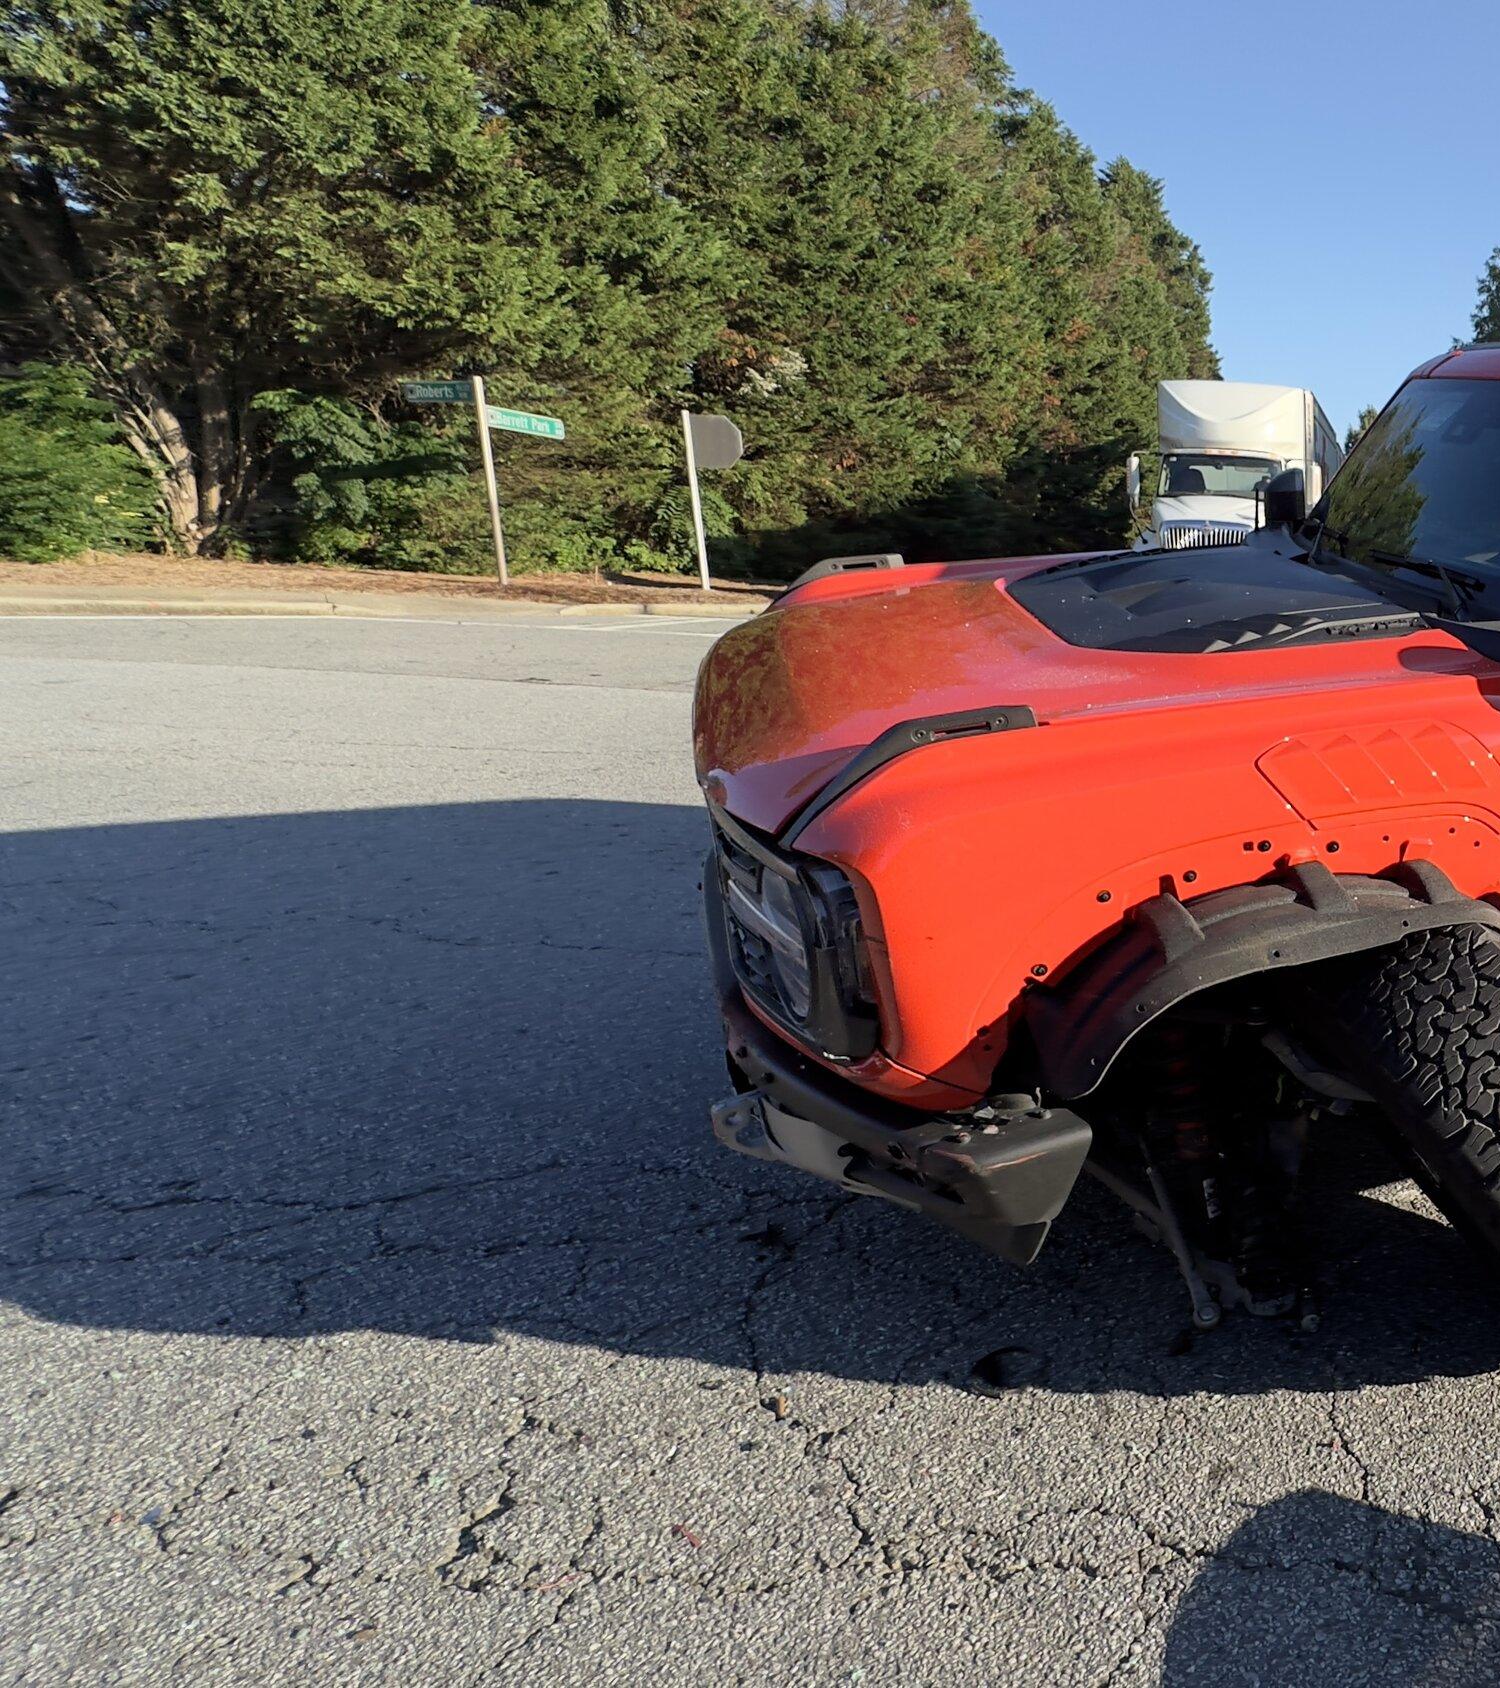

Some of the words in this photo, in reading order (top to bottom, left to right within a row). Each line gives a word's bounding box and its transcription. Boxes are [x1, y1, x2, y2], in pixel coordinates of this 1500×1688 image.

[416, 385, 454, 398] Roberts
[496, 411, 528, 429] Barrett
[531, 418, 550, 432] Park
